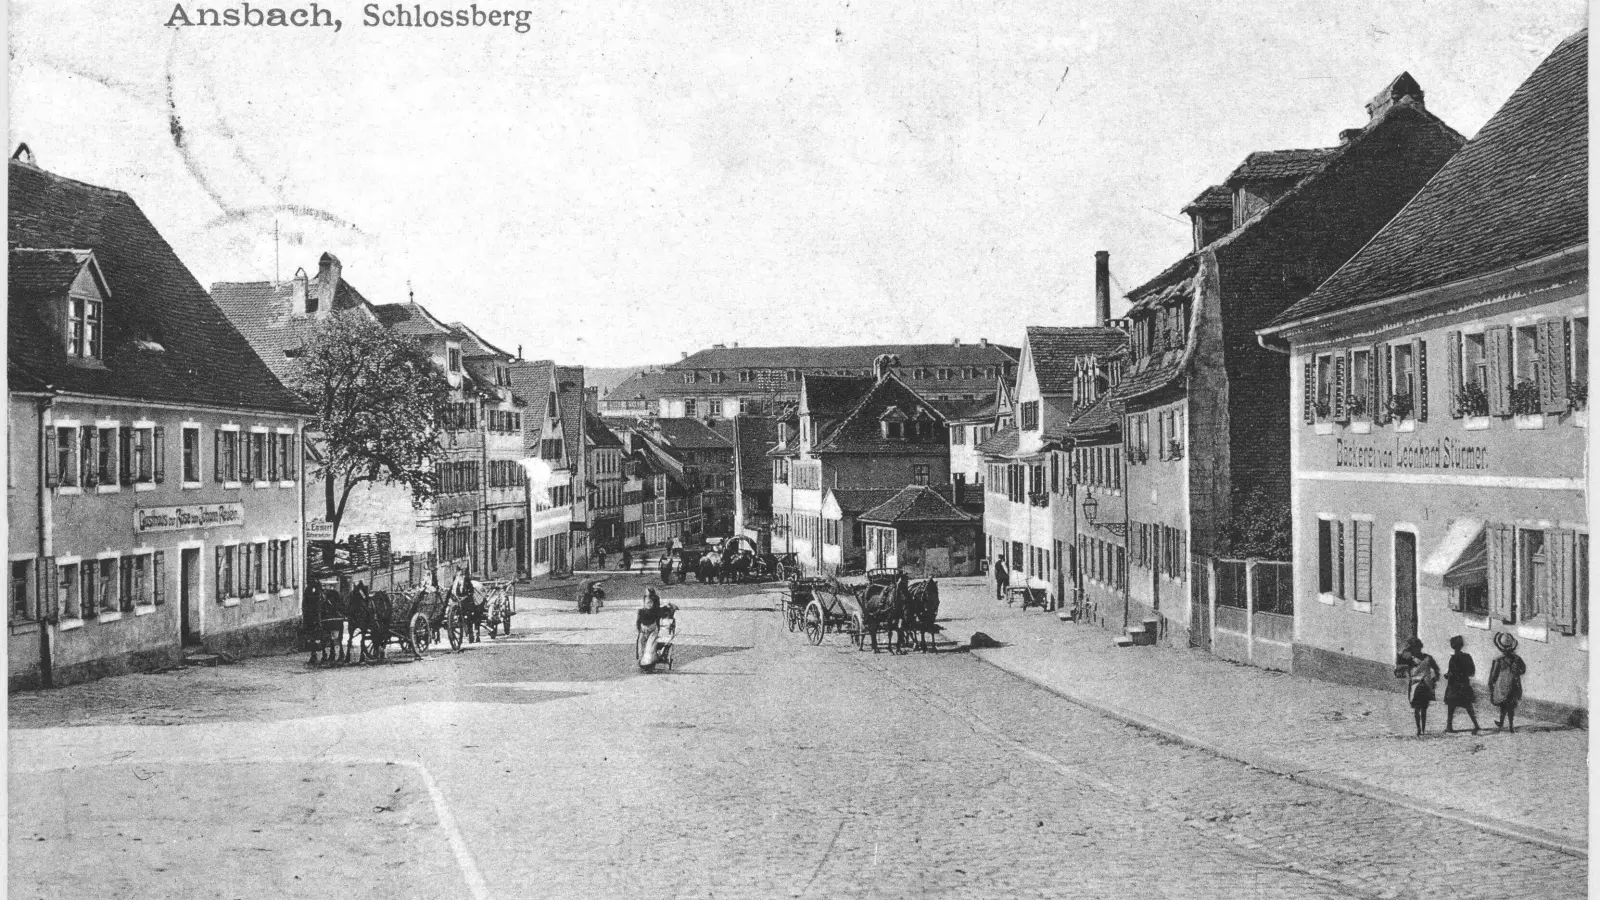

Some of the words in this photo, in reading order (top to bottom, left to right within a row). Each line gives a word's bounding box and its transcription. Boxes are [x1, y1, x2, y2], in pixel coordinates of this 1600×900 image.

[1337, 438, 1376, 467] Bäckerei
[1397, 437, 1441, 469] Leonhard
[139, 509, 168, 531] Gasthaus
[176, 508, 191, 528] Rose
